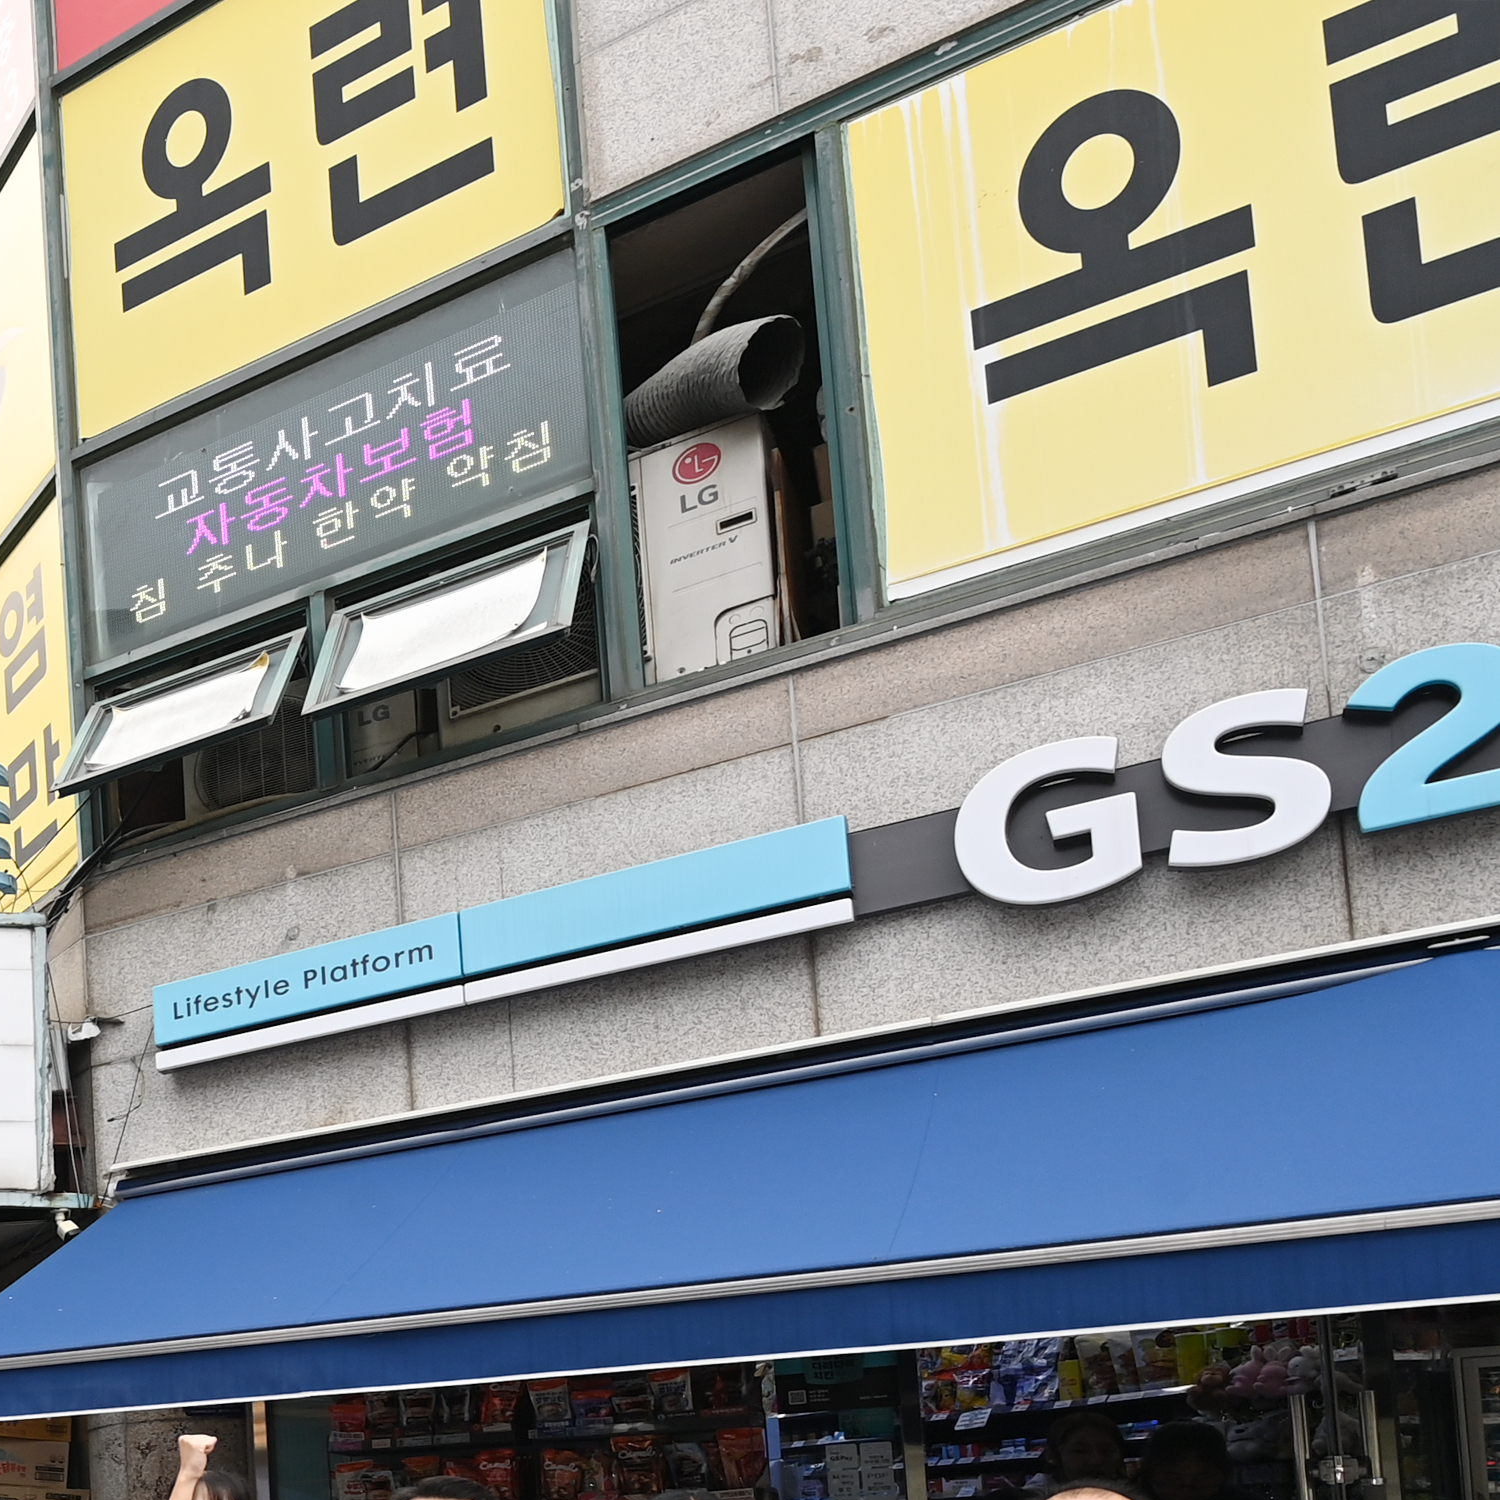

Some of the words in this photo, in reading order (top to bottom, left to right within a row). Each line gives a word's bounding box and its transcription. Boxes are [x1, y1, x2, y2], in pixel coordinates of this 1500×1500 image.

[114, 0, 495, 313] 옥련
[154, 335, 512, 521] 교통사고치료
[186, 400, 475, 556] 자동차보험
[130, 577, 168, 625] 침
[197, 530, 285, 594] 추나
[314, 478, 416, 551] 한약
[447, 421, 552, 490] 약침
[670, 539, 725, 567] INVERTER
[680, 483, 719, 514] LG
[358, 704, 390, 727] LG
[171, 974, 291, 1022] Lifestyle
[302, 939, 434, 992] Platform
